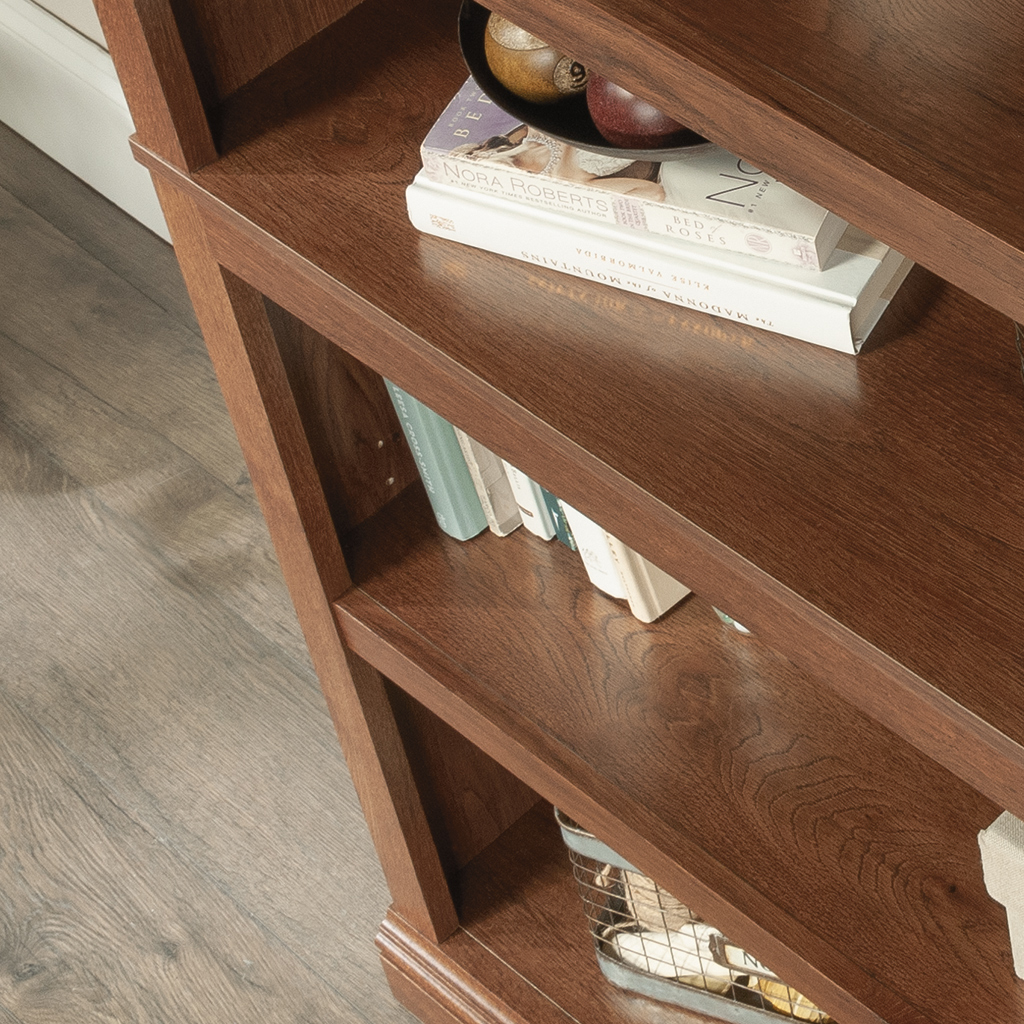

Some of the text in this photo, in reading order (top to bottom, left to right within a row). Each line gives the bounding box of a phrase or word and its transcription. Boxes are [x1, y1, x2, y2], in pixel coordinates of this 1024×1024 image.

[442, 161, 609, 213] NORA ROBERTS
[462, 180, 477, 189] NEW
[479, 185, 499, 194] YORK
[501, 191, 523, 200] TIMES
[525, 196, 575, 211] BESTSELLING
[577, 207, 607, 218] AUTHOR
[755, 179, 771, 200] NEW
[665, 224, 727, 246] ROSES
[672, 215, 705, 230] BED
[520, 250, 623, 286] MOUNTAINS
[575, 247, 711, 291] ELISE VALMORBIDA
[662, 290, 750, 322] MADONNA
[392, 386, 409, 418] LEESA
